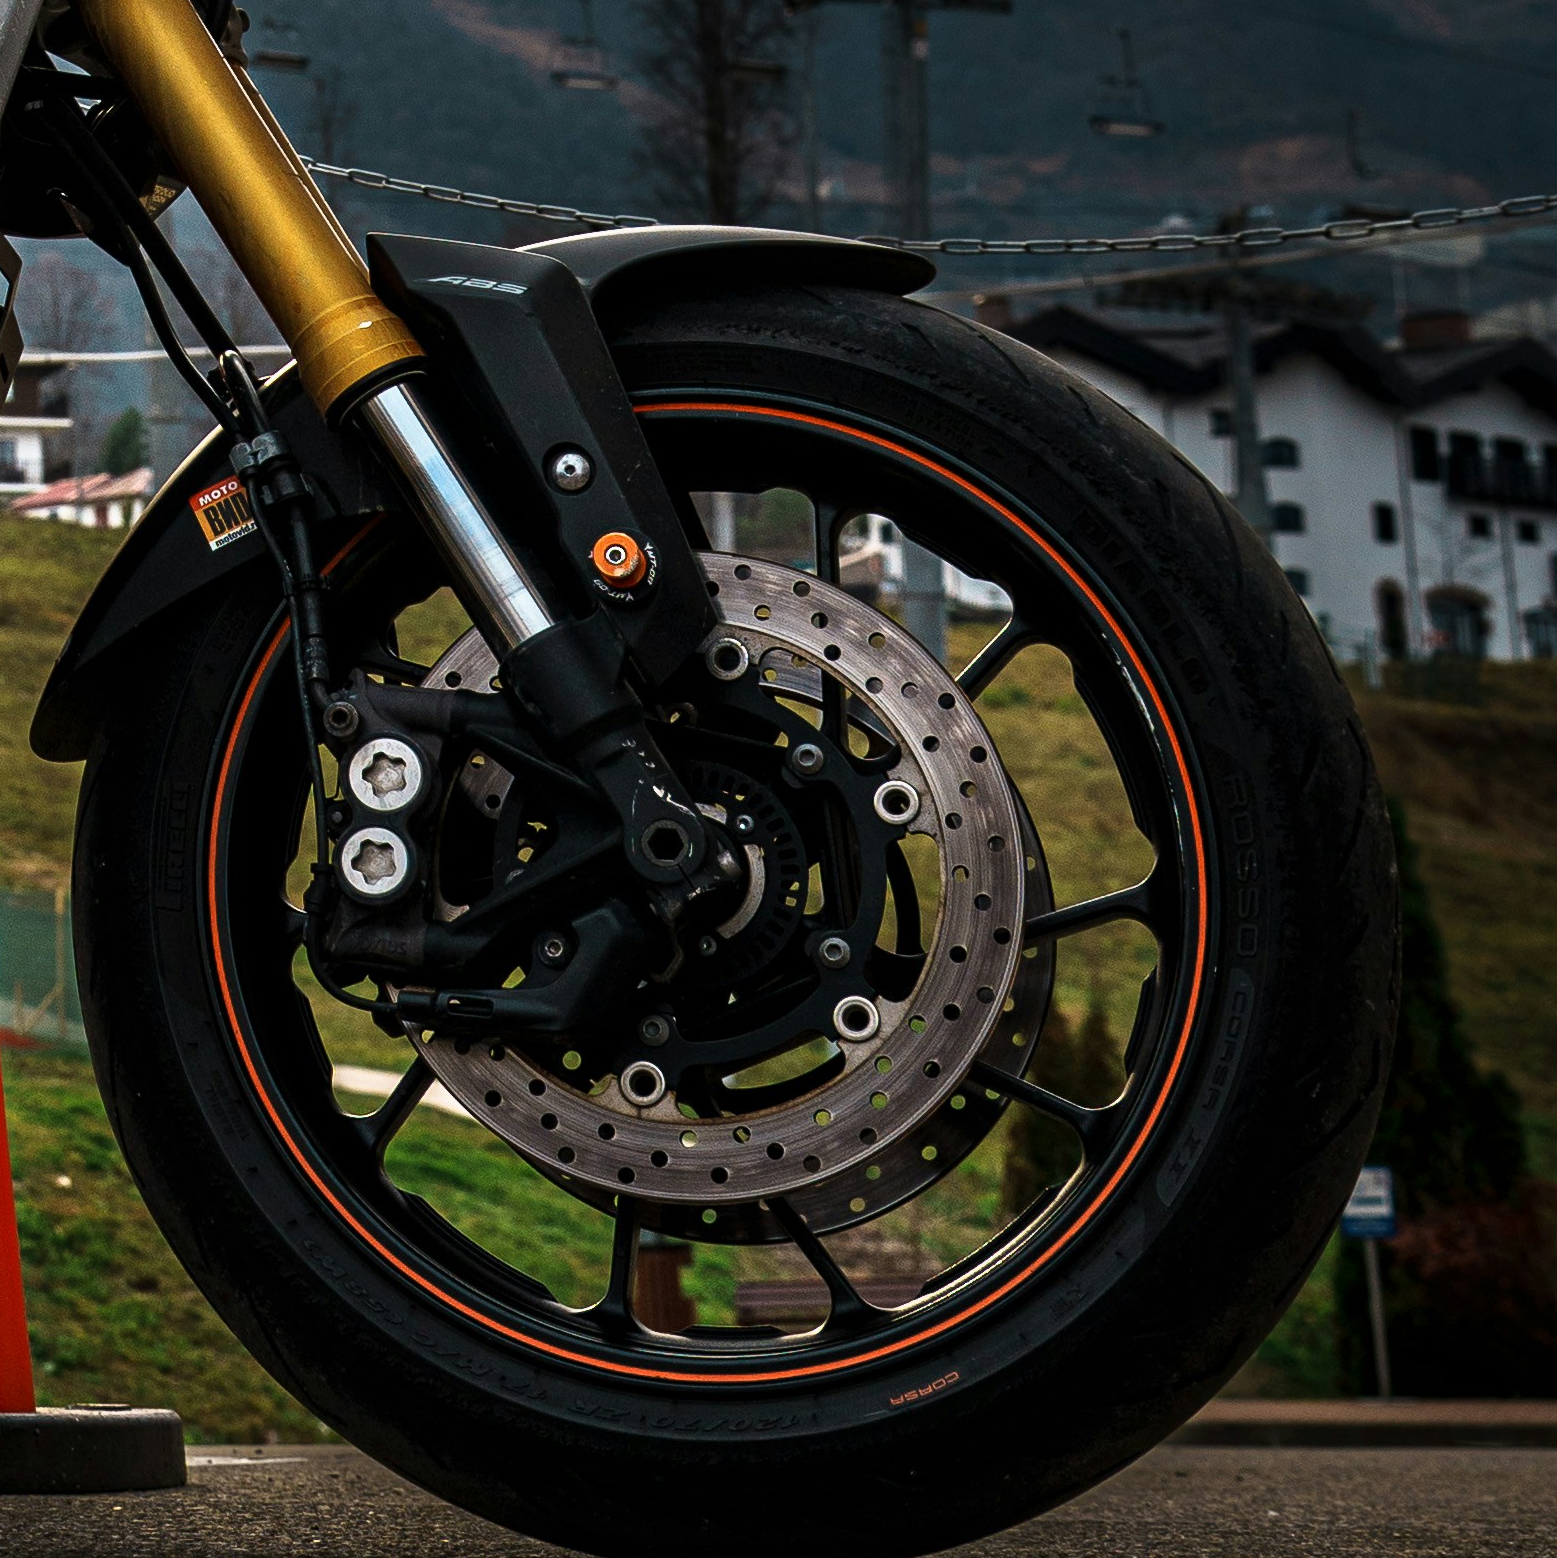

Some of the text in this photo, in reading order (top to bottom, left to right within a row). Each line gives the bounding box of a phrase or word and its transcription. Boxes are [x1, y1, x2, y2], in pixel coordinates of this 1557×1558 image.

[426, 275, 529, 295] ABS
[1075, 511, 1209, 695] DIABLO
[155, 782, 189, 912] PIRELLI
[1222, 775, 1260, 957] ROSSO
[1170, 991, 1247, 1183] CORSA II
[413, 1331, 495, 1377] M/C
[890, 1371, 961, 1406] CORSA
[648, 1411, 801, 1435] 120/70
